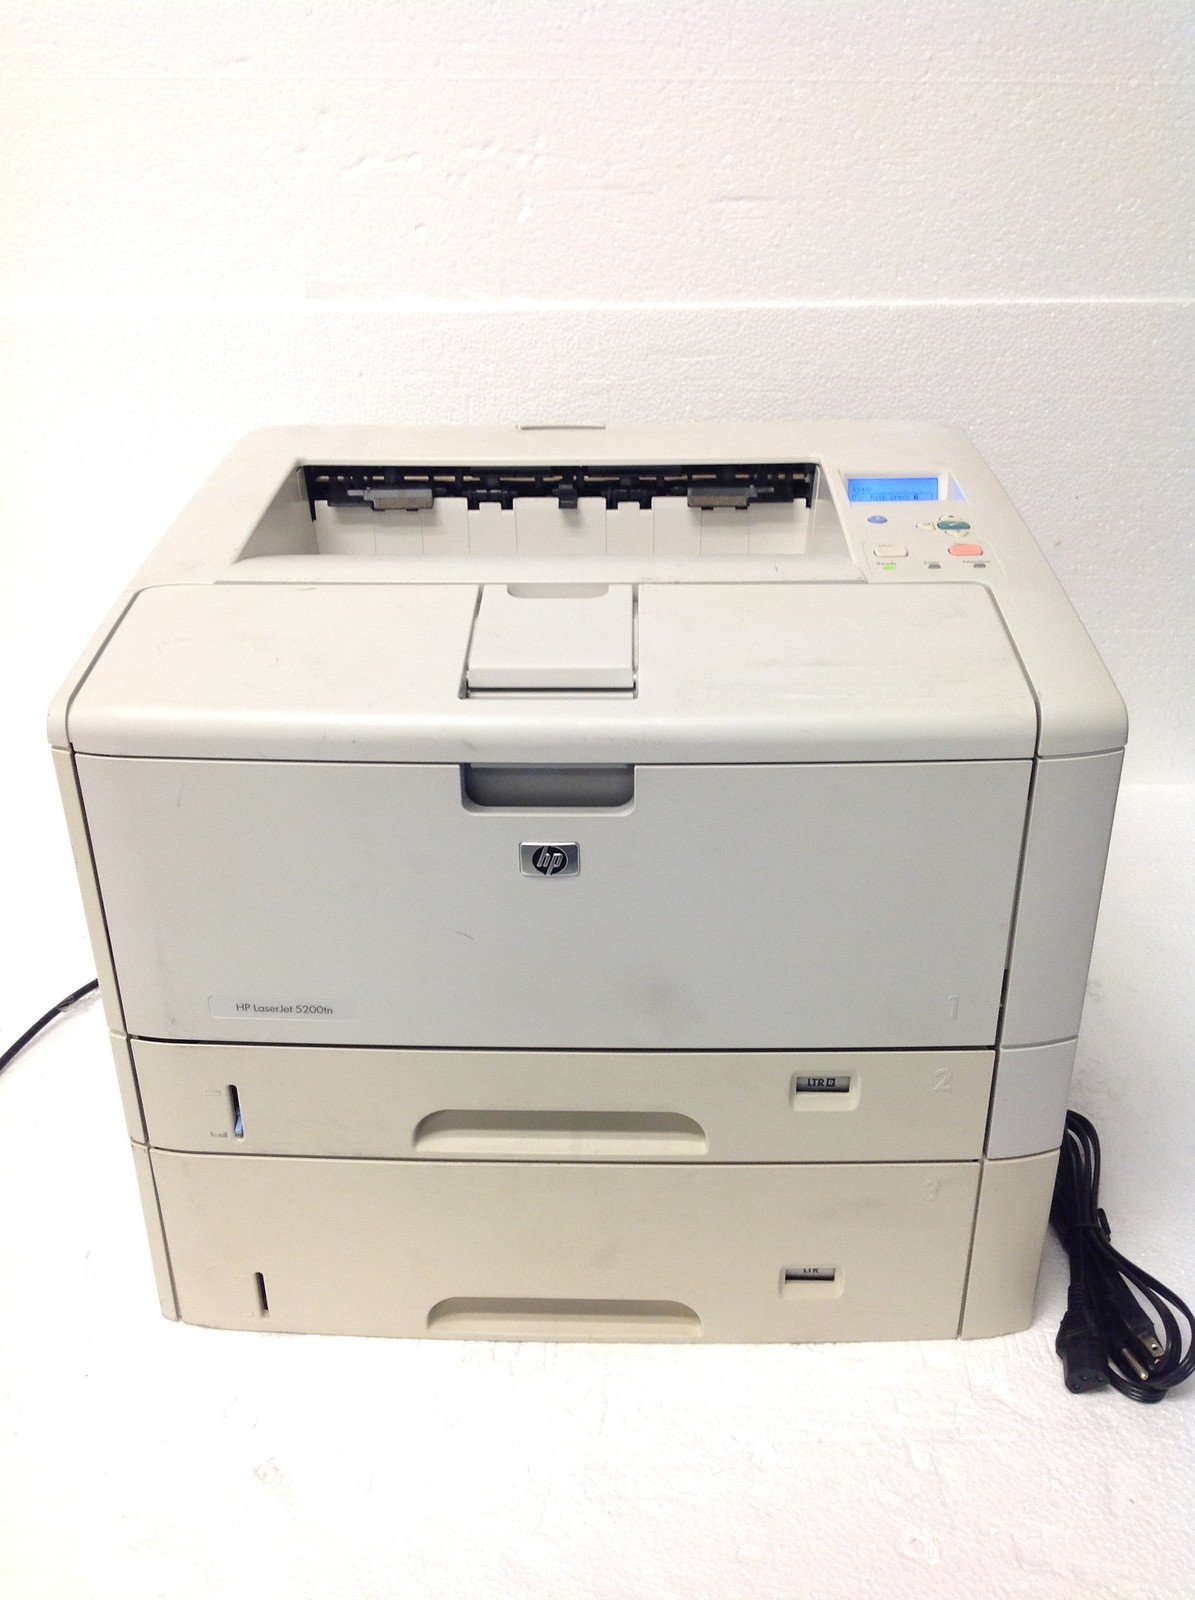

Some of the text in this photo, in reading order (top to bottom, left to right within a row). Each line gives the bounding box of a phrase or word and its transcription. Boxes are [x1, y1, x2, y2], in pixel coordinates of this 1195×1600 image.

[536, 846, 564, 875] hp
[236, 1003, 333, 1014] HP LaserJet 5200tn
[948, 994, 960, 1019] 1
[807, 1078, 825, 1087] LTR
[933, 1068, 951, 1091] 2
[922, 1179, 941, 1200] 3
